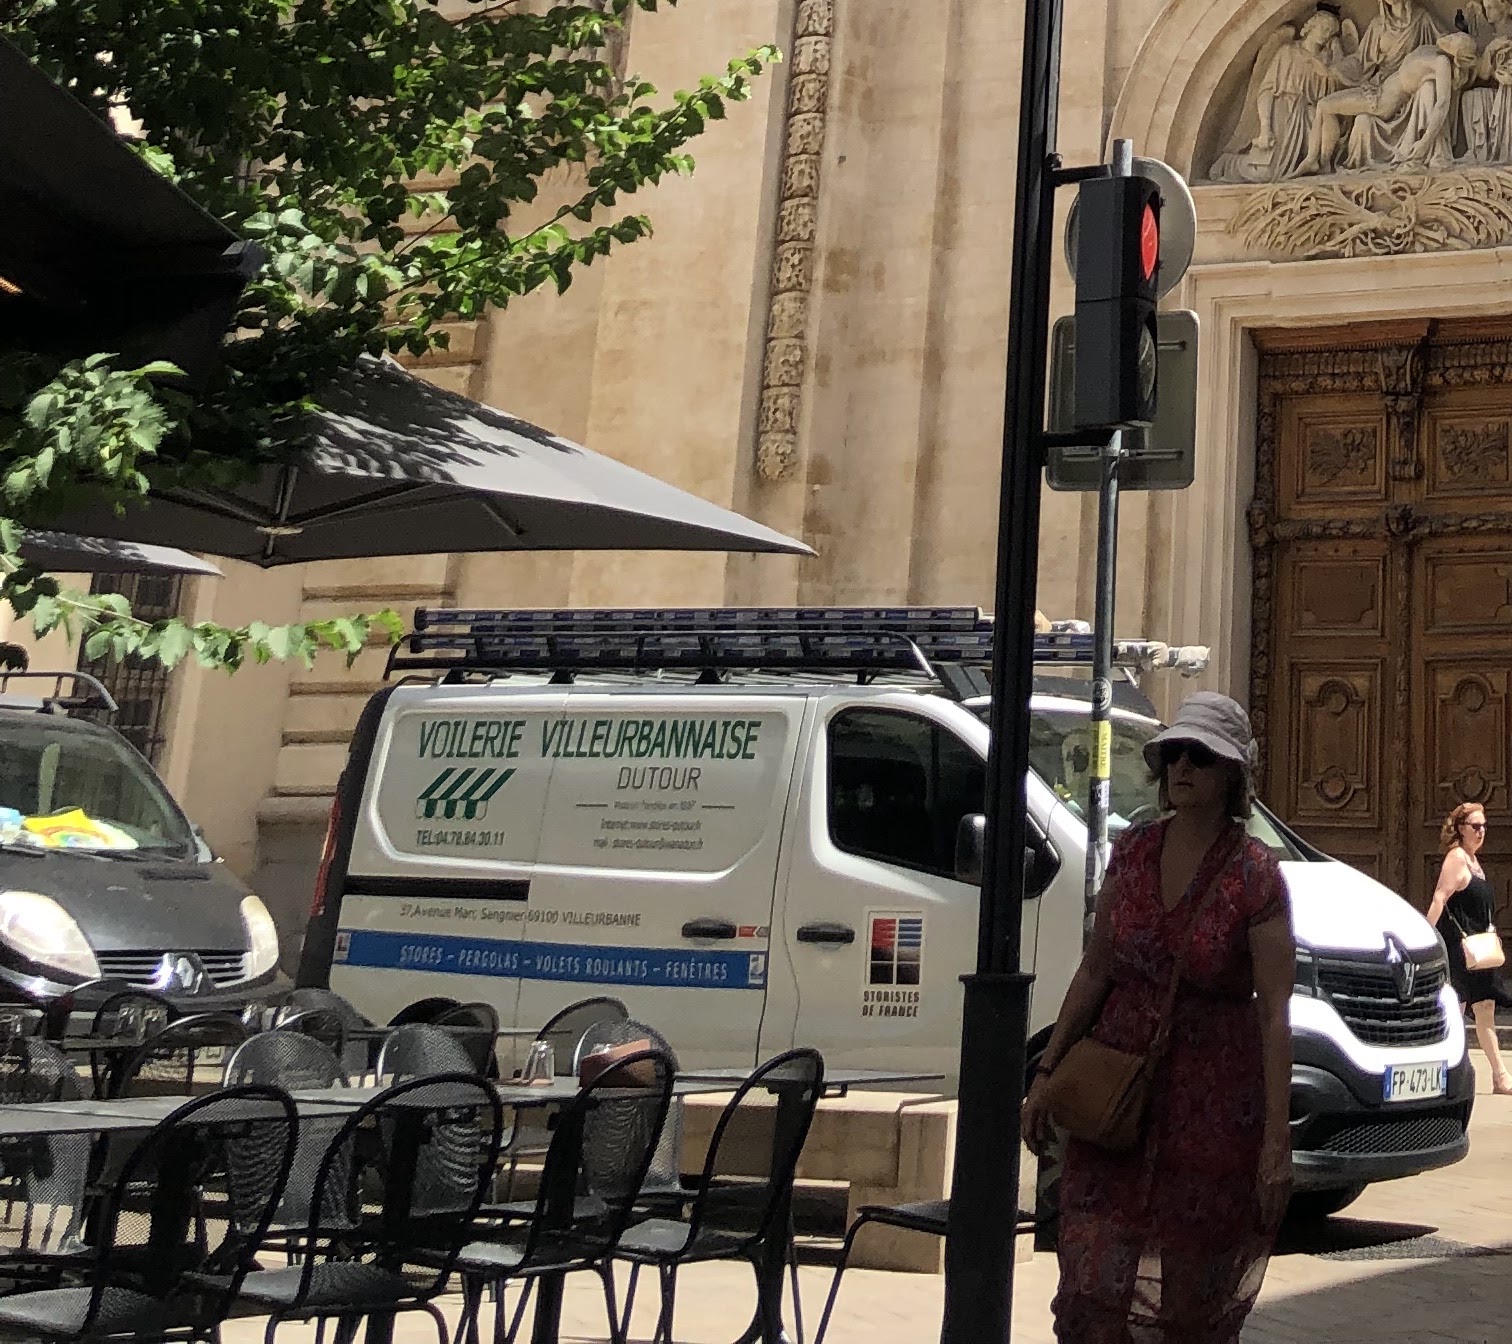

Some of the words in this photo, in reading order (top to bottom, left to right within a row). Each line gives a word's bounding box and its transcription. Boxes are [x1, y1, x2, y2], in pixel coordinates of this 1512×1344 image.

[418, 720, 526, 758] VOILERIE
[541, 719, 762, 759] VILLEURBANNAISE
[616, 766, 702, 790] DUTOUR
[562, 911, 642, 926] VILLEURBANNE
[400, 945, 443, 964] STORES
[458, 949, 518, 970] PERGOLAS
[535, 954, 581, 973] VOLETS
[586, 957, 648, 978] ROULANTS
[665, 957, 728, 980] FENÊTRES
[863, 990, 920, 1003] STORISTES
[878, 1005, 919, 1017] FRANCE
